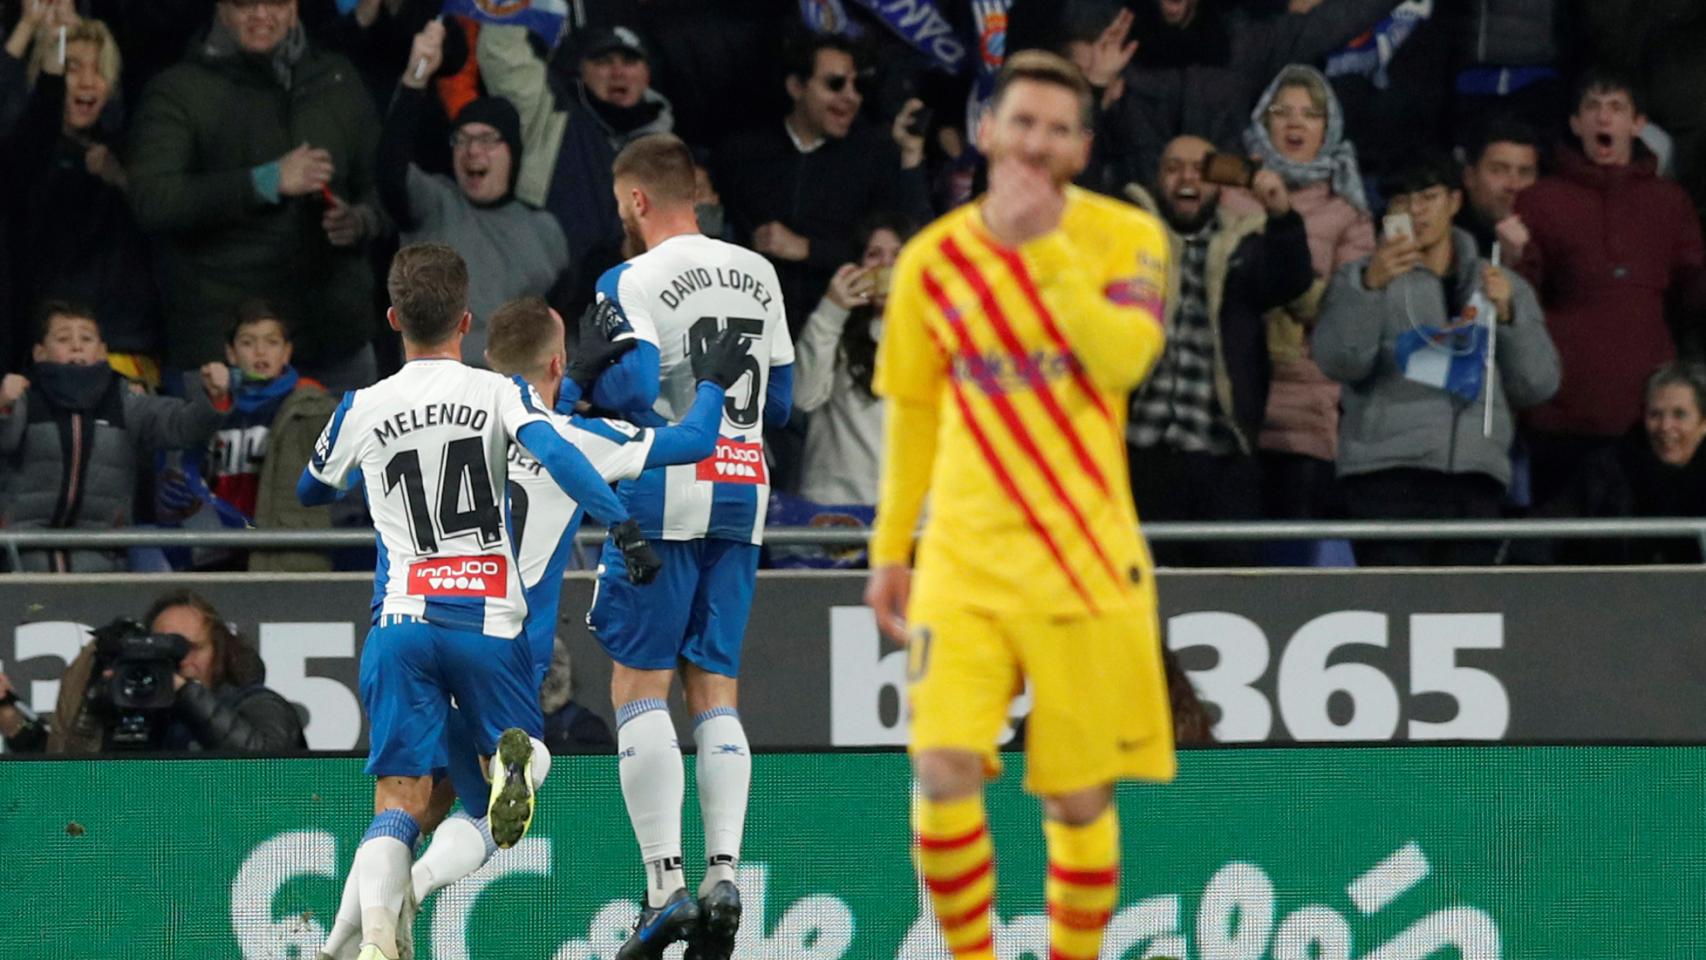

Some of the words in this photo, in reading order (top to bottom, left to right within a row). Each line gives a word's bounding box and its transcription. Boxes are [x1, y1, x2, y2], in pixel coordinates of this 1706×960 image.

[659, 268, 713, 311] DAVID
[716, 267, 773, 312] LOPEZ
[373, 403, 488, 447] MELENDO
[381, 436, 504, 557] 14
[428, 576, 486, 591] VOOM
[830, 606, 1511, 746] b365
